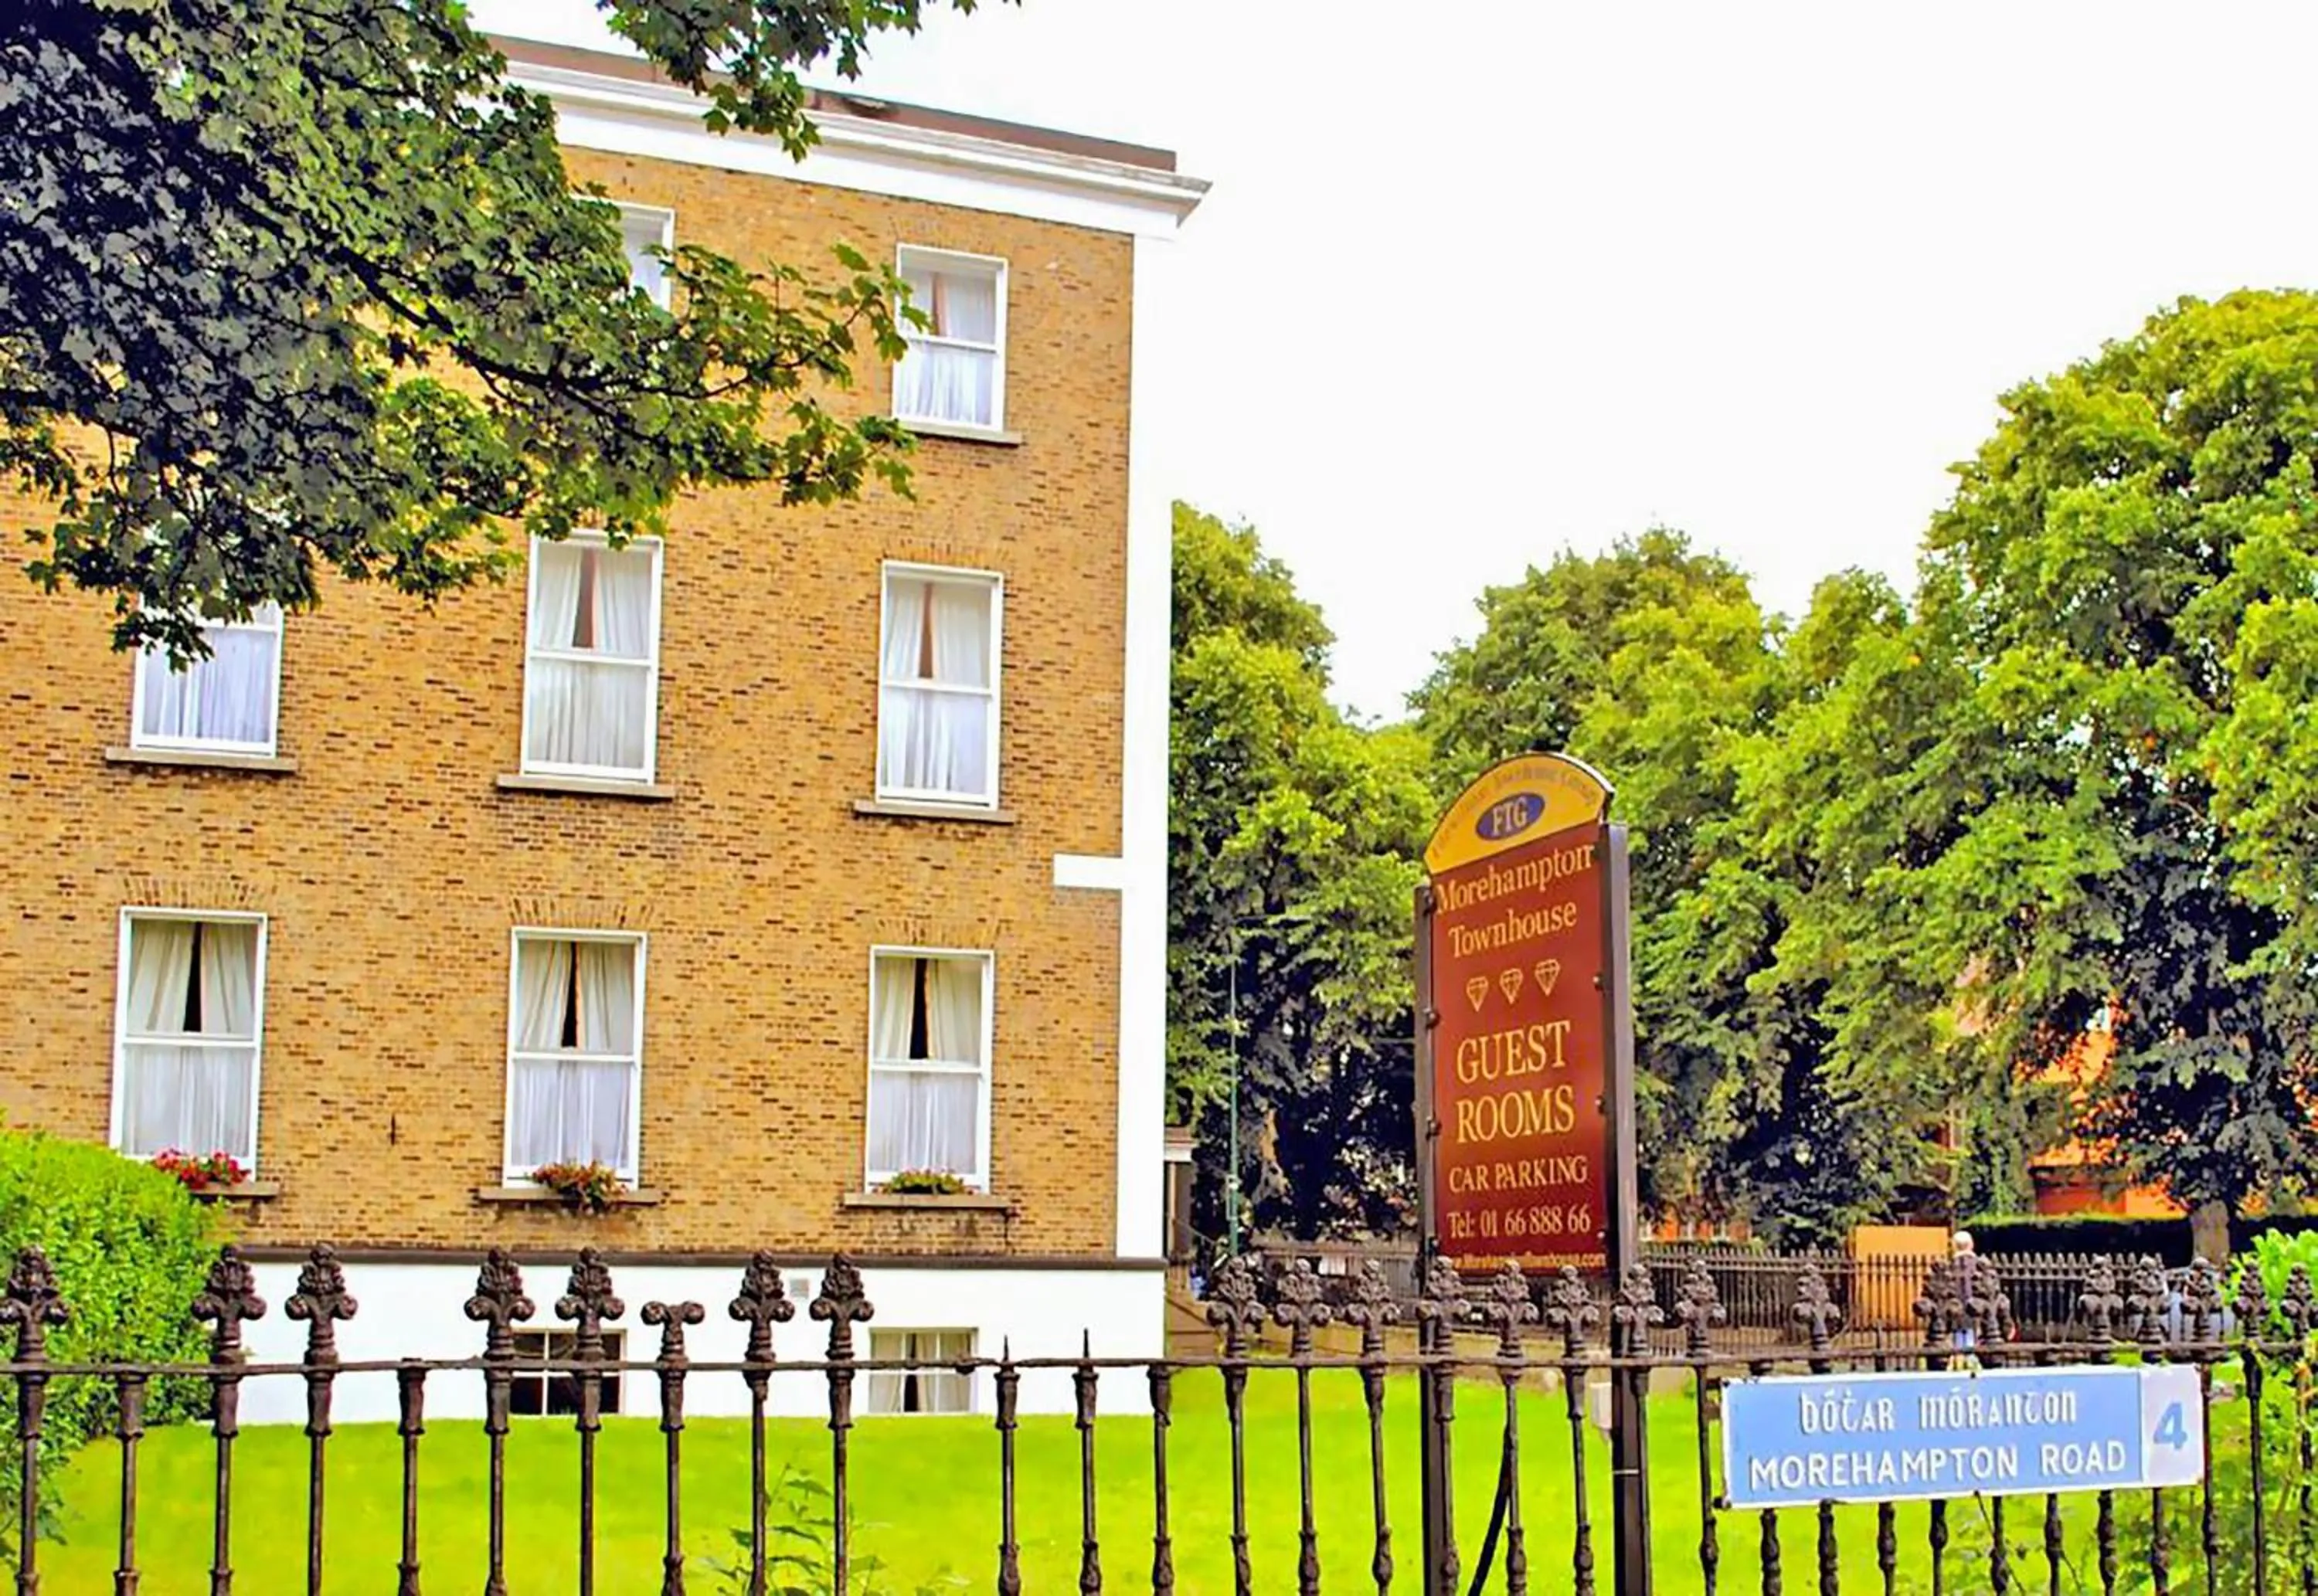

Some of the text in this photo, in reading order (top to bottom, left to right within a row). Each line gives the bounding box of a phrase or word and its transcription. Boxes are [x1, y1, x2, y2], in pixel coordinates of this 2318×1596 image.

[1436, 844, 1595, 915] Morehampton
[1448, 901, 1577, 958] Townhouse
[1456, 1020, 1570, 1083] GUEST
[1456, 1085, 1575, 1143] ROOMS
[1449, 1155, 1589, 1193] CAR PARKING
[1446, 1204, 1592, 1238] Tel: 01 66 888 66
[2153, 1401, 2189, 1450] 4
[1749, 1439, 2126, 1491] MOREHAMPTON ROAD
